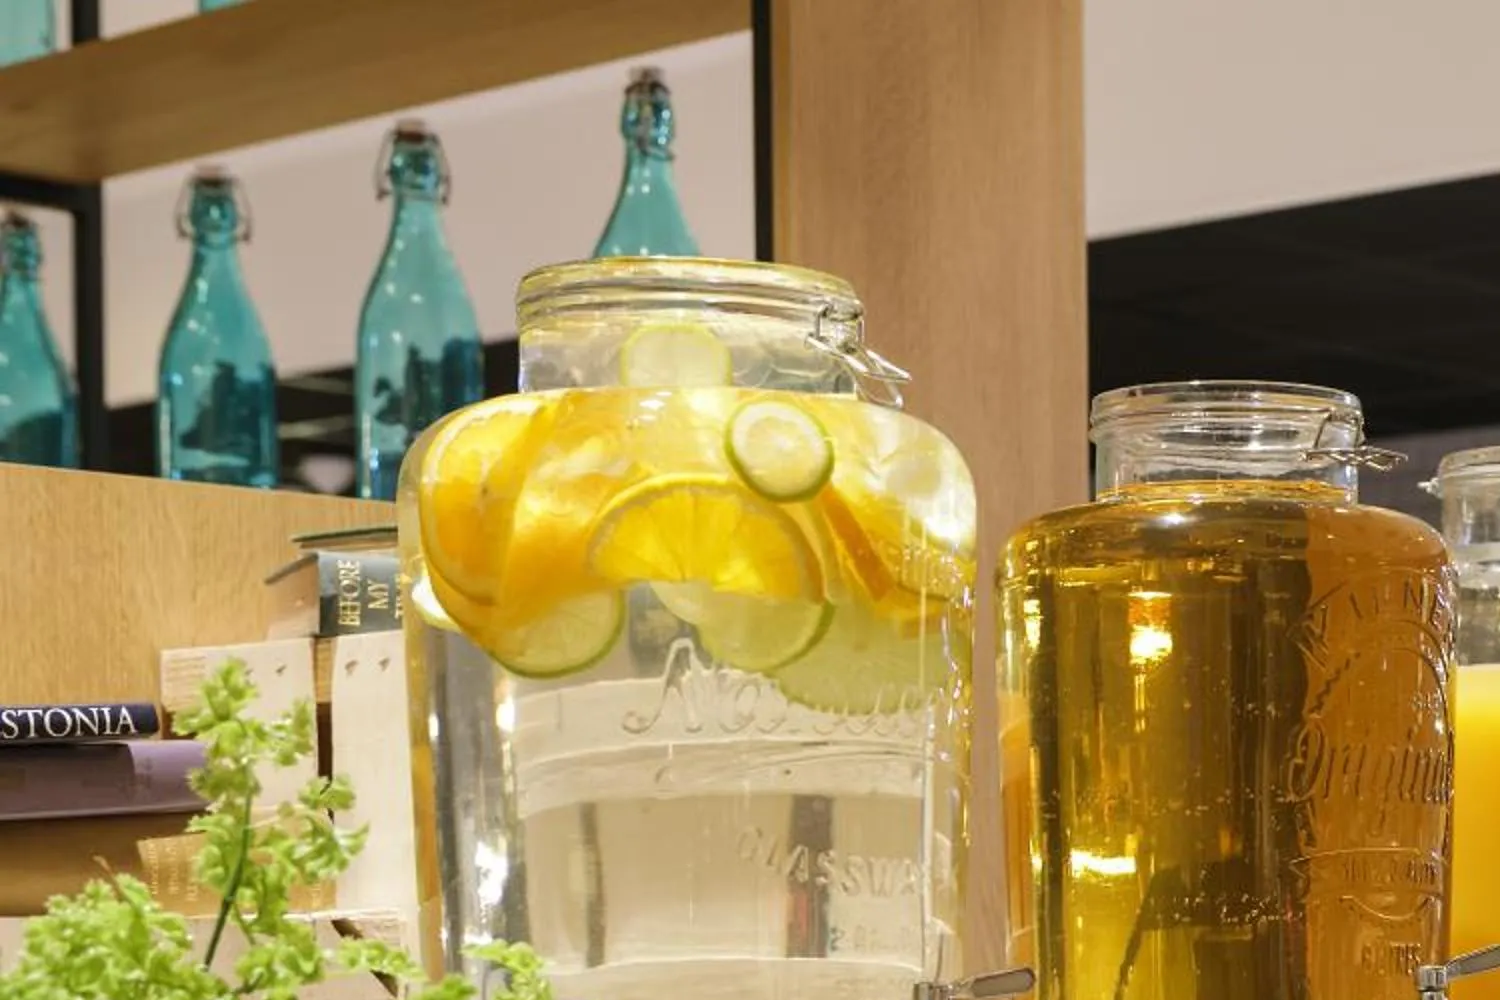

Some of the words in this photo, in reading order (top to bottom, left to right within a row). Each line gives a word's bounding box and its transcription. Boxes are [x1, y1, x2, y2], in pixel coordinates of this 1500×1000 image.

[337, 559, 362, 627] BEFORE
[367, 579, 390, 610] MY
[0, 704, 138, 740] STONIA
